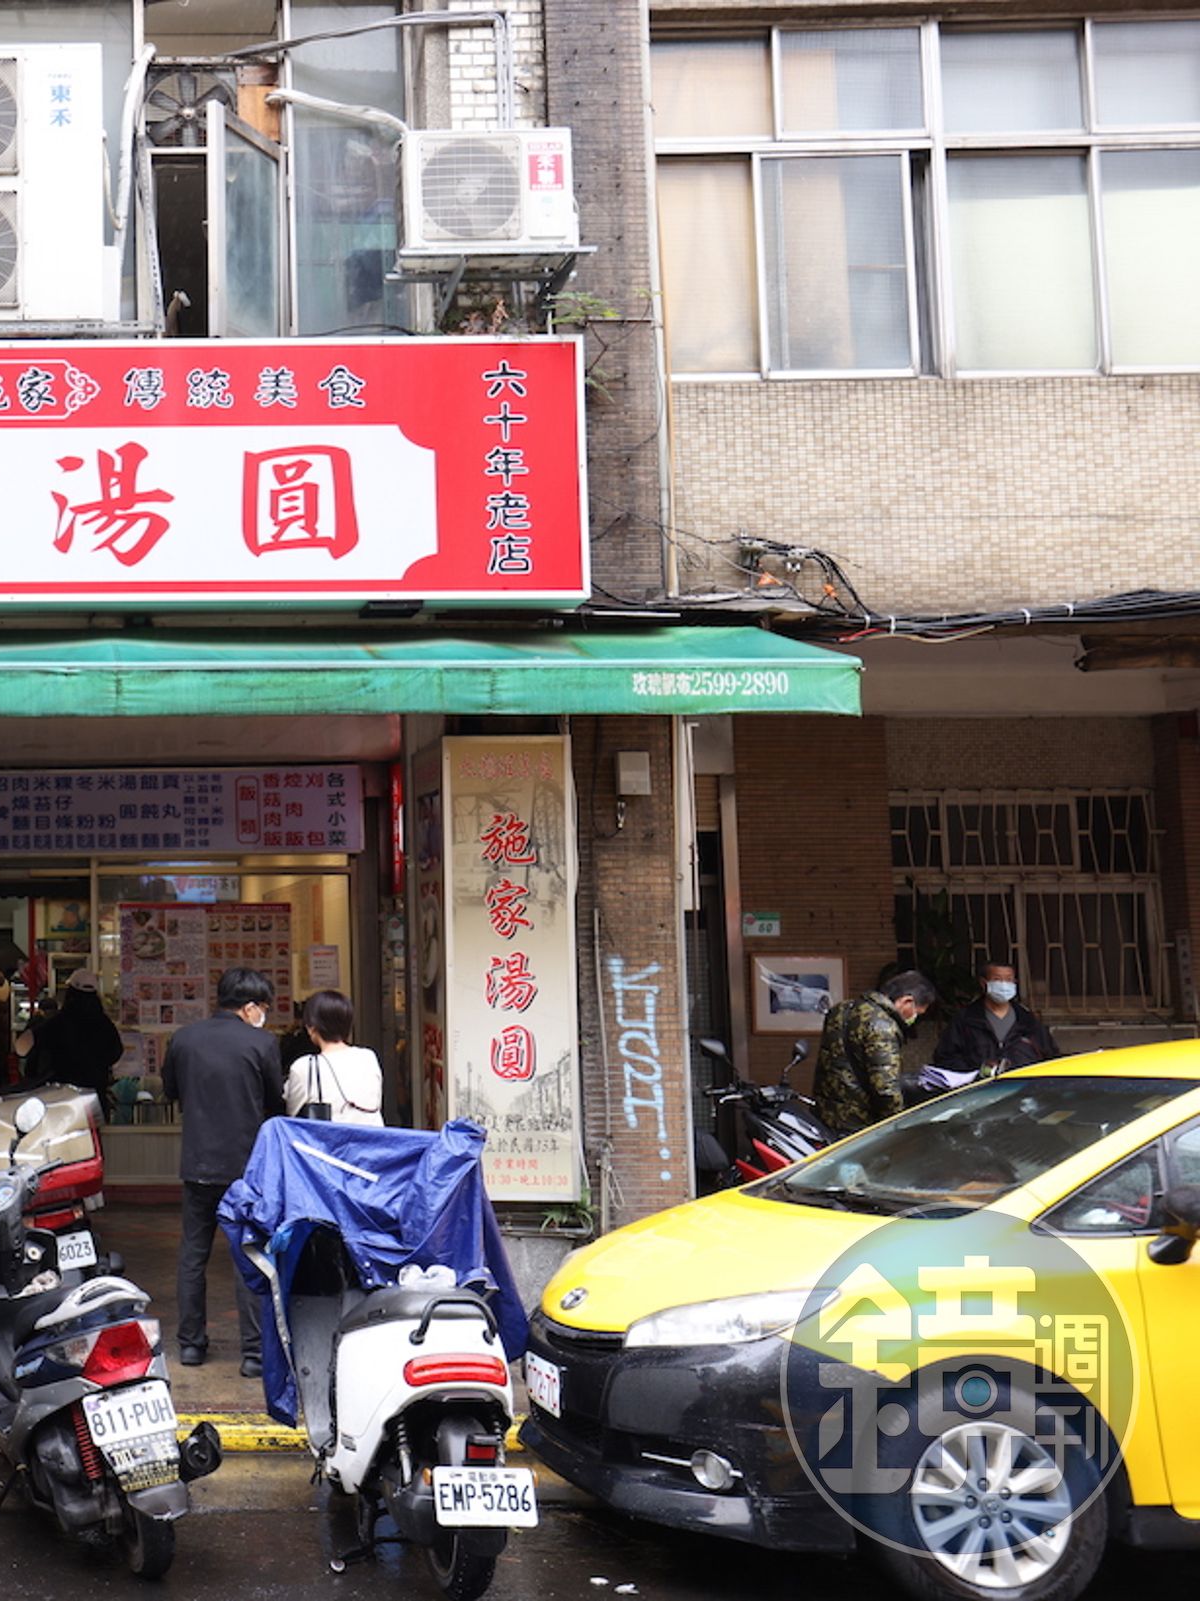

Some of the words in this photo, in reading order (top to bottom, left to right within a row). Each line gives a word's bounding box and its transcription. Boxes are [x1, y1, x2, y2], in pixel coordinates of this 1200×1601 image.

[123, 364, 366, 409] 傳統美食
[483, 360, 534, 576] 六十年老店
[305, 772, 325, 846] 刈包
[327, 772, 347, 846] 各式小菜
[480, 812, 537, 1081] 施家湯圓
[59, 1241, 93, 1262] 6023
[91, 1397, 174, 1437] 811-PUH
[439, 1483, 532, 1512] EMP-5286
